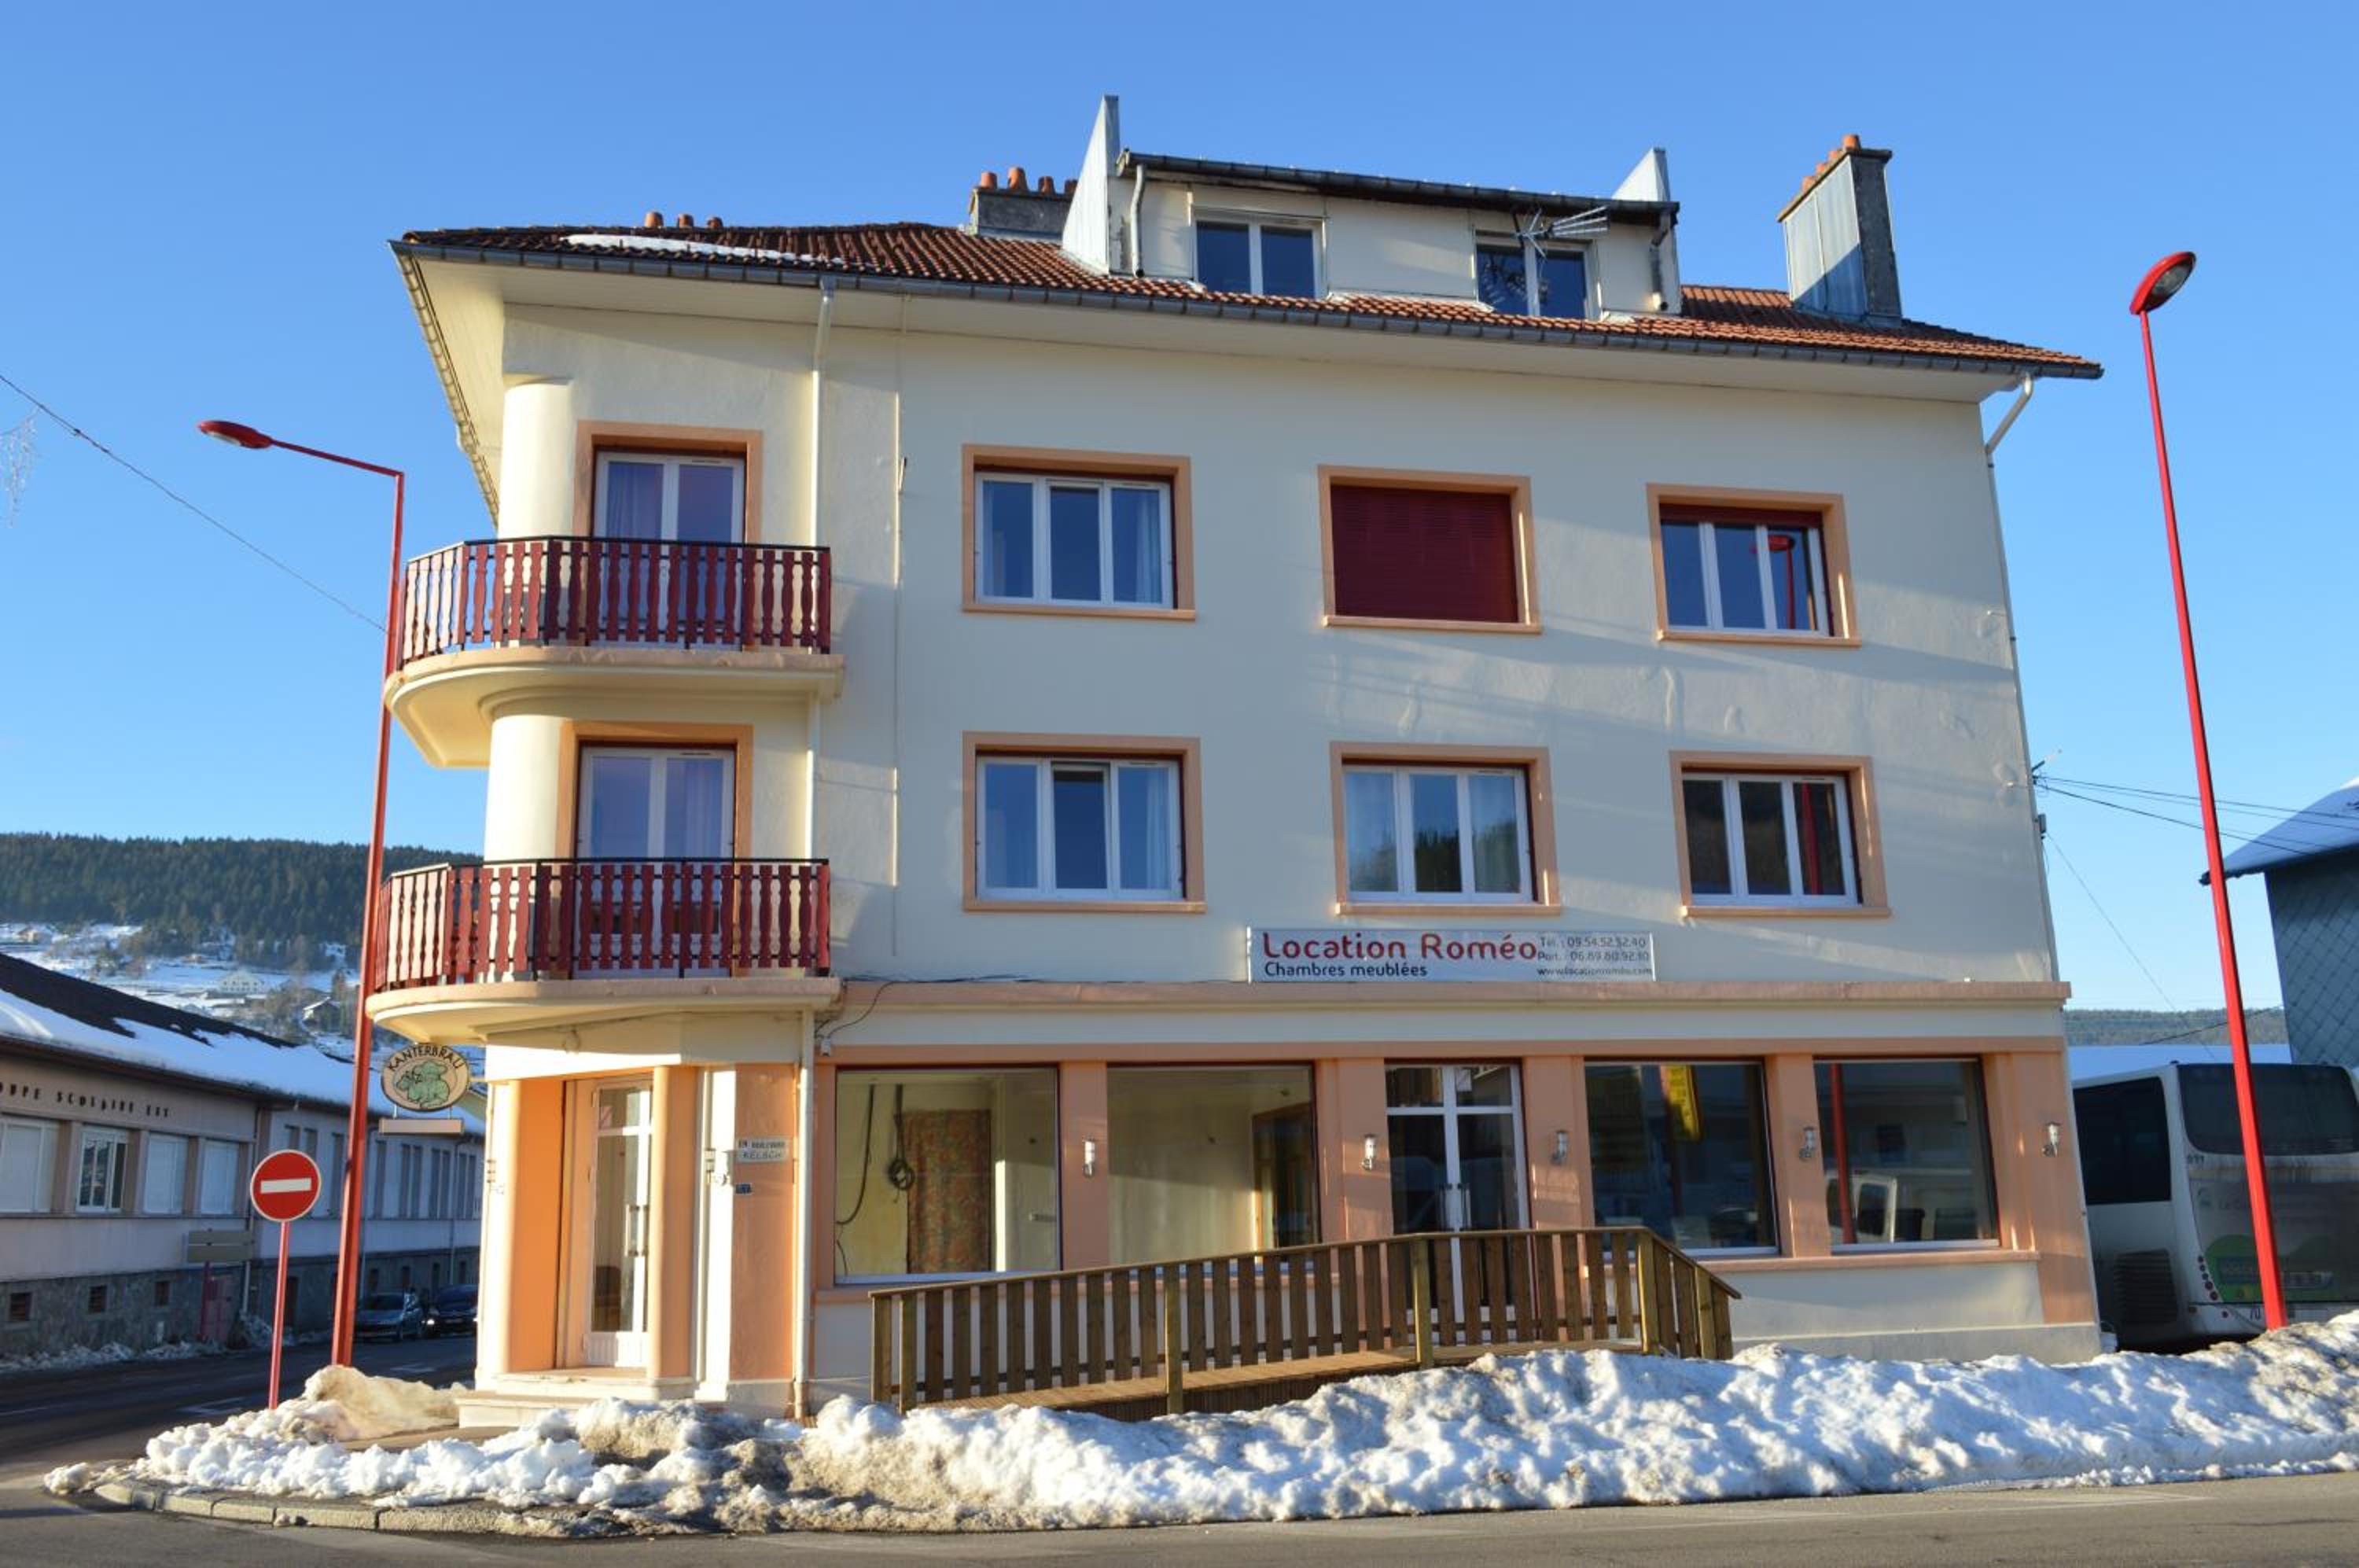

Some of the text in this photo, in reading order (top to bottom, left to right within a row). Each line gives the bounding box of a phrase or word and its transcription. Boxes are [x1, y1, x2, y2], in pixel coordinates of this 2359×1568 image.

[1263, 932, 1537, 959] Location Roméo
[1264, 962, 1428, 977] Chambres meublées
